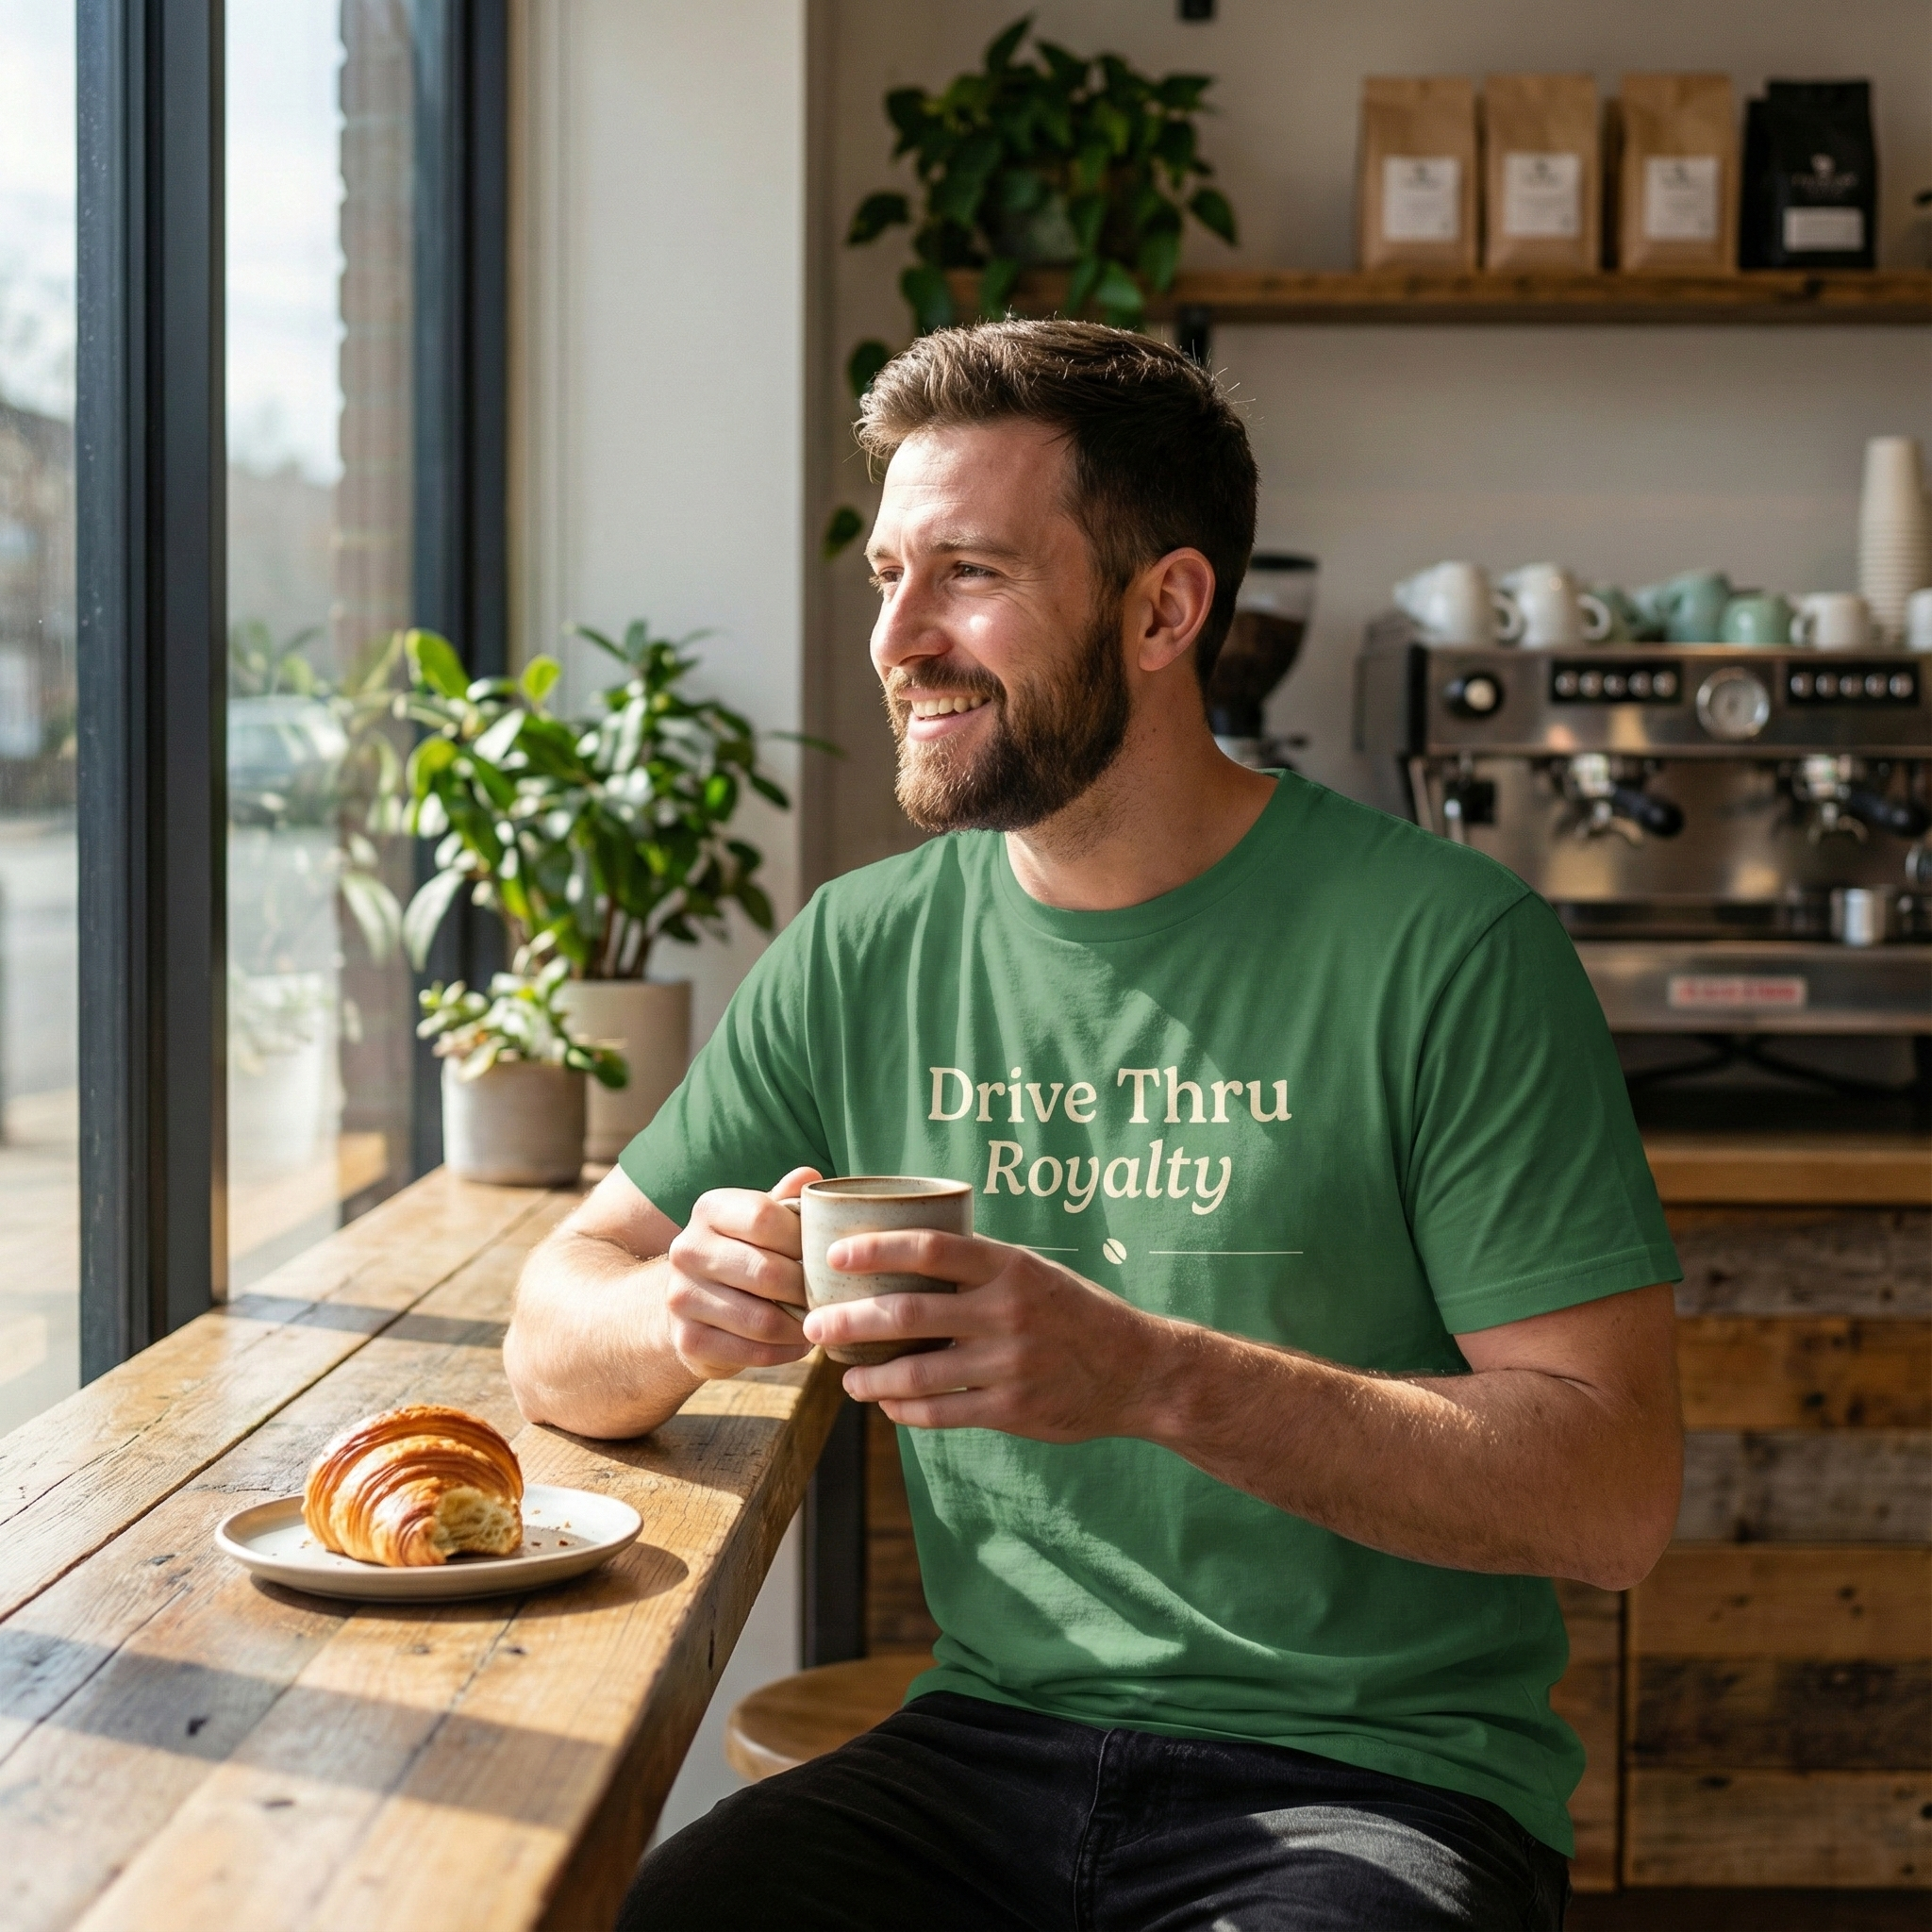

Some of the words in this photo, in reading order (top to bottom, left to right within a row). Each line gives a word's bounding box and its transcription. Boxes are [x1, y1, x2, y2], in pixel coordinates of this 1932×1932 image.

[927, 1066, 1098, 1124] Drive
[1117, 1066, 1292, 1124] Thru
[982, 1139, 1232, 1215] Royalty
